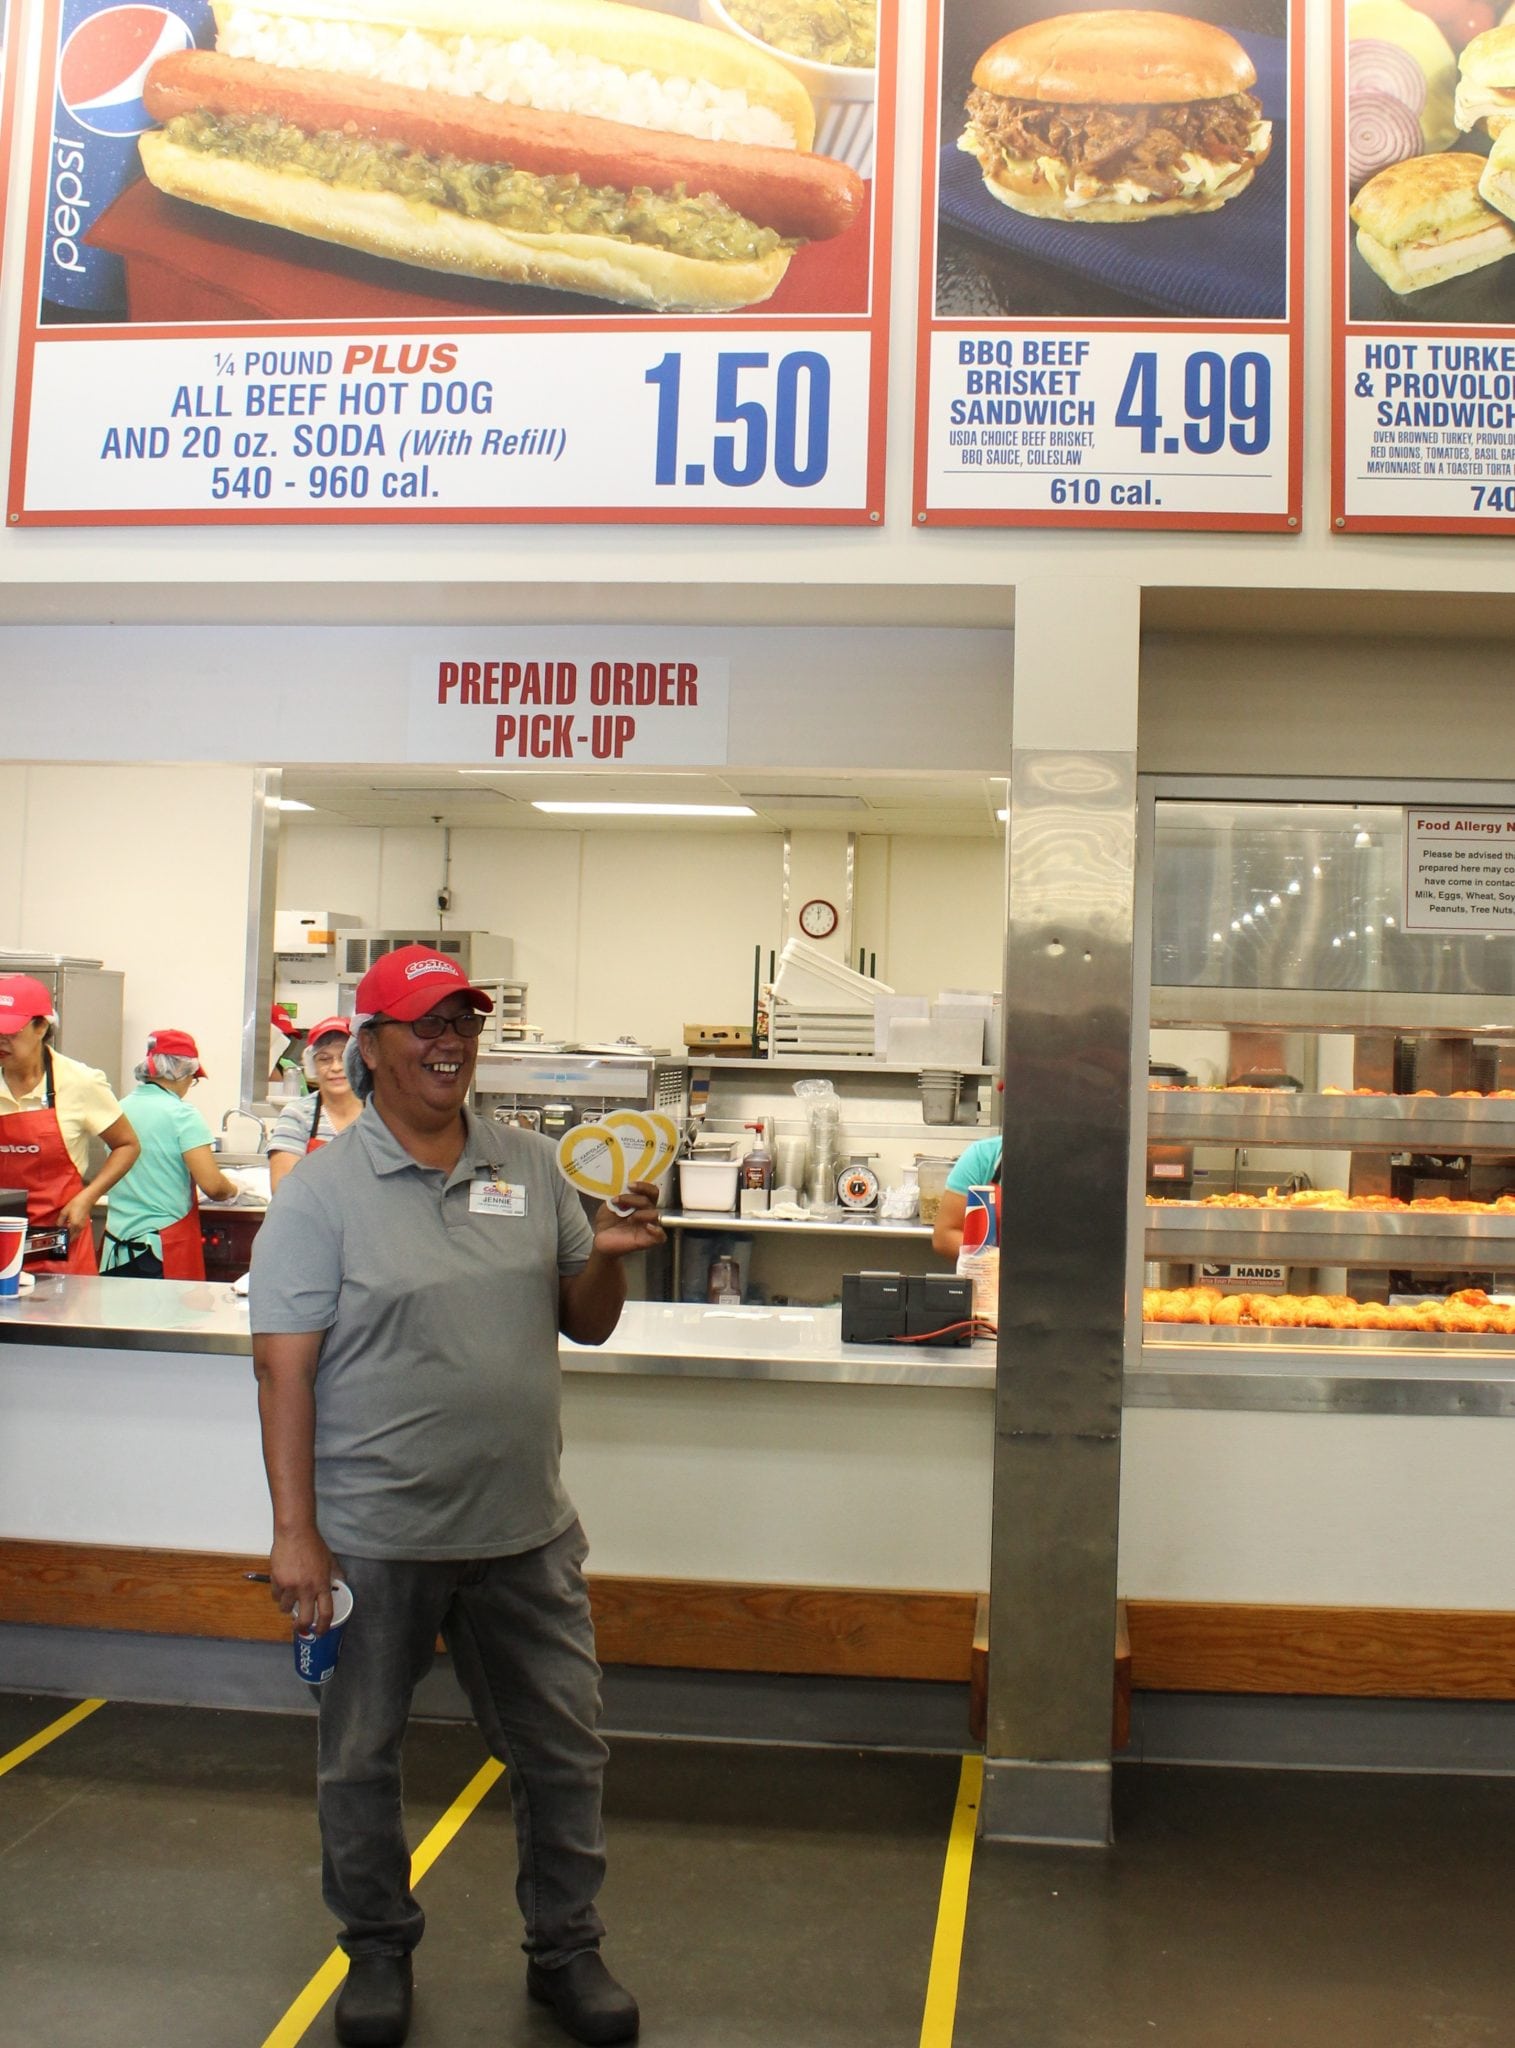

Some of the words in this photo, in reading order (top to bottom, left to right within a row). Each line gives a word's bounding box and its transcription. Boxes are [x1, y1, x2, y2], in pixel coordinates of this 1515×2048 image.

[52, 136, 90, 273] pepsi
[245, 351, 333, 376] POUND
[342, 343, 459, 374] PLUS
[958, 340, 1013, 368] BBQ
[1023, 341, 1090, 366] BEEF
[1365, 344, 1418, 370] HOT
[1427, 345, 1515, 371] TURKE
[966, 370, 1081, 395] BRISKET
[1354, 372, 1375, 398] &
[1385, 373, 1515, 400] PROVOLO
[171, 385, 232, 417] ALL
[246, 384, 327, 416] BEEF
[339, 382, 409, 415] HOT
[421, 381, 493, 414] DOG
[1115, 351, 1271, 455] 4.99
[645, 350, 831, 488] 1.50
[950, 399, 1095, 426] SANDWICH
[100, 427, 170, 459] AND
[182, 426, 221, 458] 20
[234, 432, 277, 458] oz.
[293, 424, 385, 457] SODA
[399, 429, 473, 462] (With
[481, 428, 567, 461] Refill)
[949, 430, 977, 446] USDA
[981, 431, 1018, 446] CHOICE
[1022, 431, 1046, 446] BEEF
[1050, 431, 1095, 448] BRISKET,
[1373, 431, 1395, 443] OVEN
[1398, 431, 1438, 444] BROWNED
[1442, 432, 1473, 446] TURKEY,
[1476, 433, 1515, 446] PROVOLO
[961, 449, 982, 466] BBQ
[986, 449, 1023, 467] SAUCE,
[1027, 450, 1082, 465] COLESLAW
[1370, 446, 1386, 459] RED
[1389, 447, 1423, 460] ONIONS,
[1426, 447, 1472, 461] TOMATOES,
[1475, 448, 1498, 460] BASIL
[1367, 461, 1421, 474] MAYONNAISE
[1424, 462, 1435, 474] ON
[1438, 462, 1444, 474] A
[1447, 463, 1483, 475] TOASTED
[1486, 463, 1511, 475] TORTA
[211, 466, 272, 499] 540
[309, 465, 369, 498] 960
[382, 464, 439, 498] cal.
[1051, 478, 1100, 504] 610
[1110, 479, 1162, 505] cal.
[1470, 486, 1515, 512] 740
[438, 662, 577, 705] PREPAID
[590, 661, 698, 706] ORDER
[495, 714, 636, 759] PICK-UP
[1417, 820, 1450, 831] Food
[1455, 821, 1502, 833] Allergy
[1423, 850, 1452, 859] Please
[1455, 850, 1466, 859] be
[1468, 851, 1502, 860] advised
[1505, 852, 1515, 860] th
[1419, 864, 1458, 873] prepared
[1483, 866, 1501, 874] may
[1425, 877, 1446, 886] have
[1475, 878, 1483, 886] in
[1415, 890, 1436, 899] Milk,
[1438, 891, 1463, 900] Eggs,
[1466, 892, 1496, 900] Wheat,
[1429, 904, 1468, 914] Peanuts,
[1471, 905, 1490, 913] Tree
[483, 1196, 512, 1206] JENNIE
[1237, 1268, 1280, 1278] HANDS
[300, 1643, 313, 1676] pepsi
